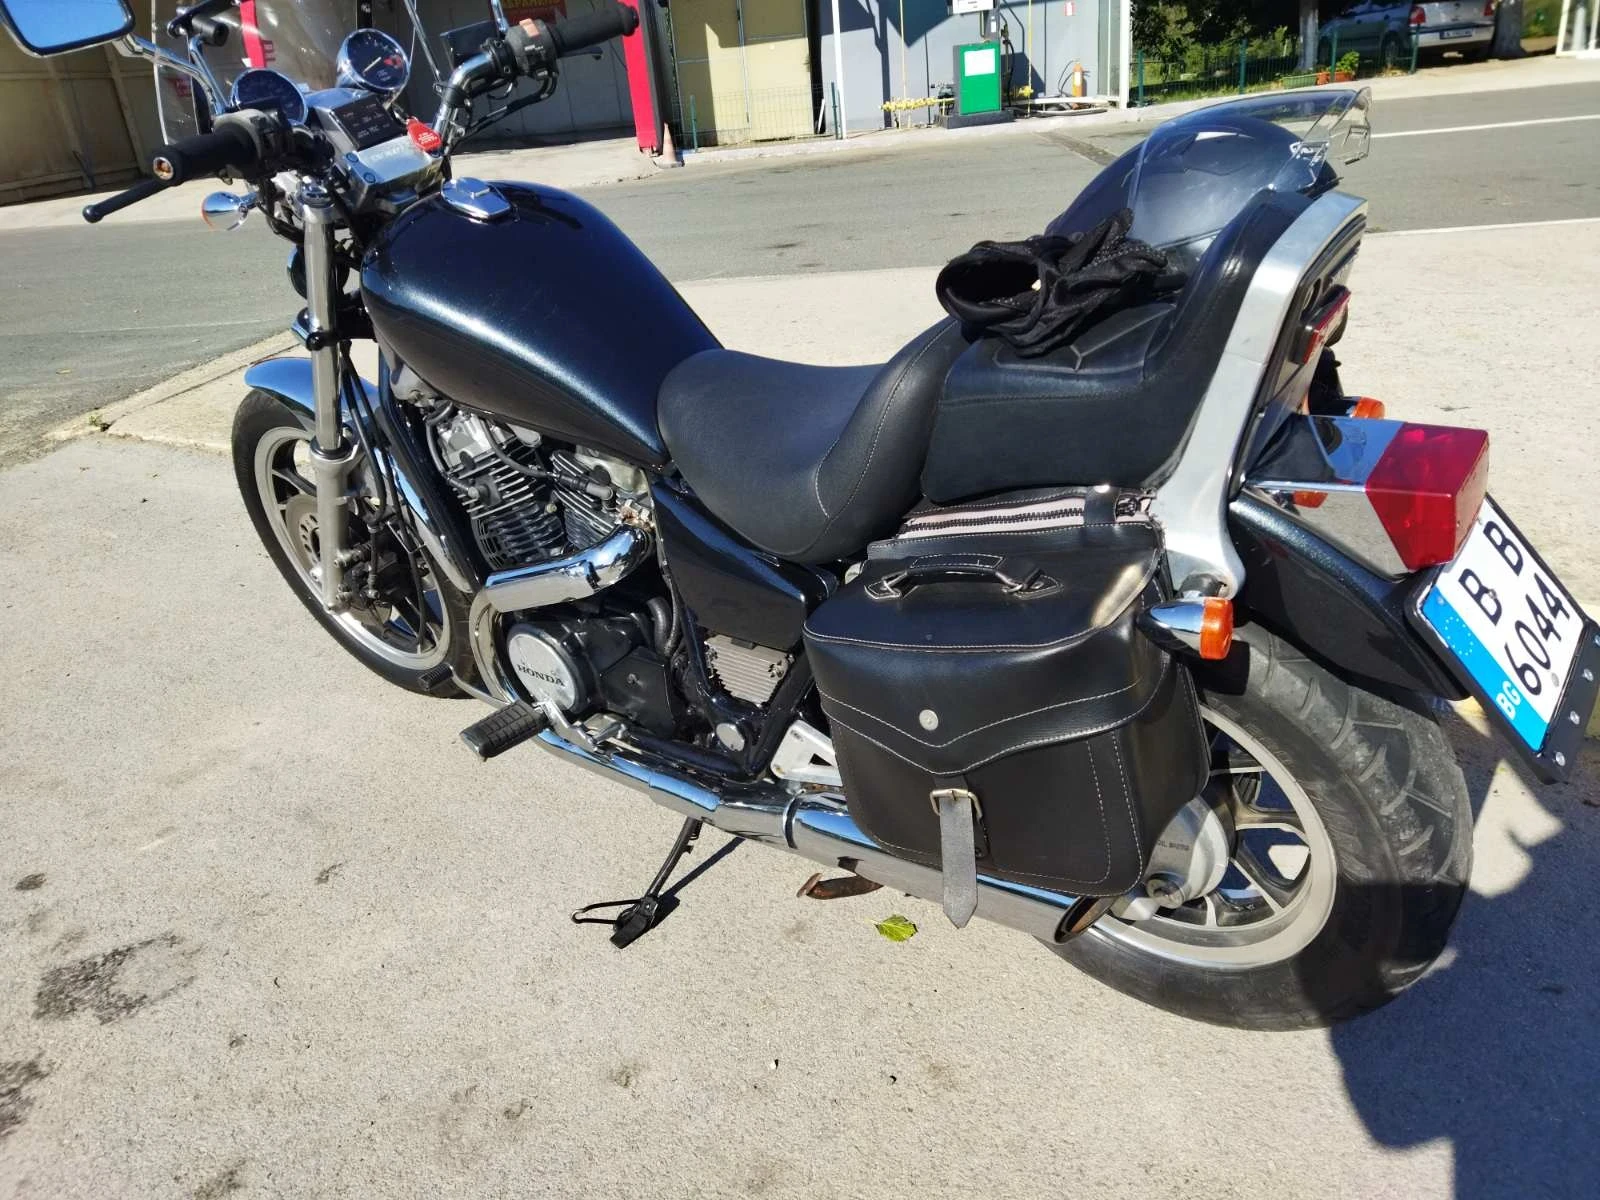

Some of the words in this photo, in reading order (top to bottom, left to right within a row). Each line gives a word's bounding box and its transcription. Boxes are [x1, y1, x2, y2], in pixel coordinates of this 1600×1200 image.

[1458, 568, 1502, 626] B
[1483, 520, 1524, 576] B
[1504, 573, 1570, 696] 6044
[516, 663, 566, 687] HONDA
[1495, 680, 1521, 720] BG
